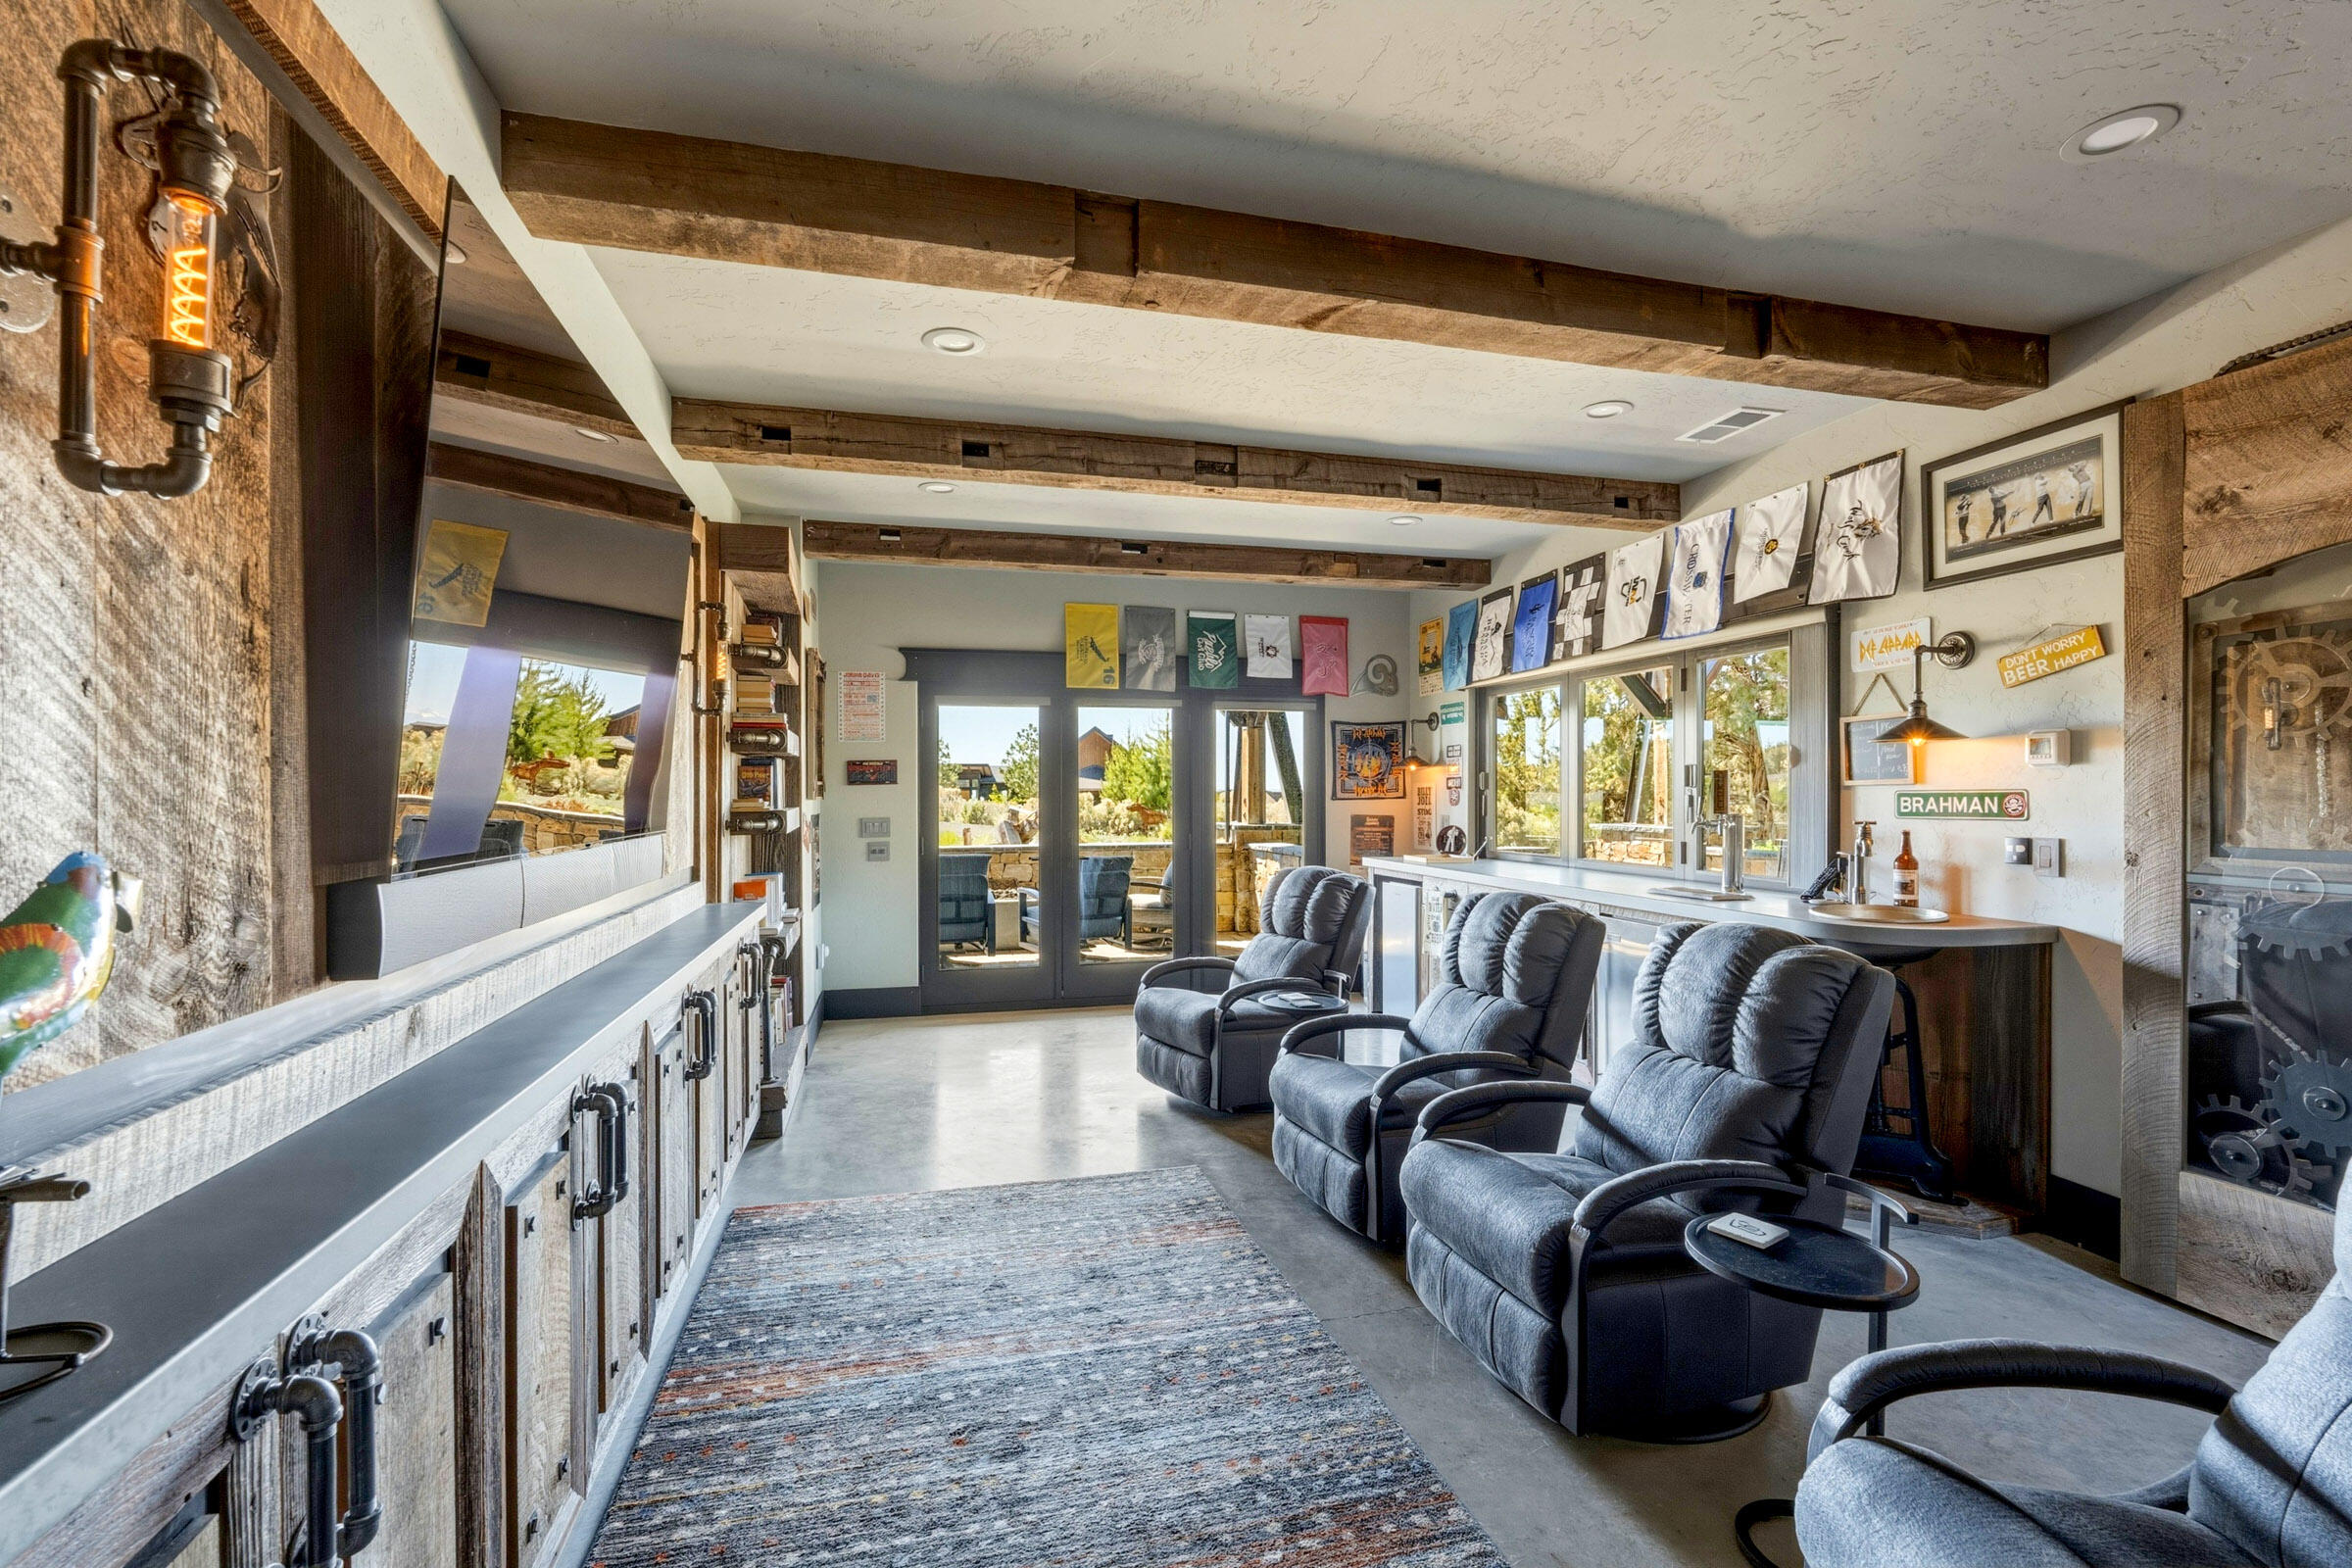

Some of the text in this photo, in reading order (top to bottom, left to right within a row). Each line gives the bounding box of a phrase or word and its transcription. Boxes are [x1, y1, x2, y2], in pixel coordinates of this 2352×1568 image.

[1683, 543, 1699, 625] CROSSWTER
[2003, 646, 2098, 685] BEER HAPPY
[2005, 632, 2086, 668] DON'T WORRY
[1102, 666, 1115, 685] 16
[1899, 796, 1998, 813] BRAHMAN
